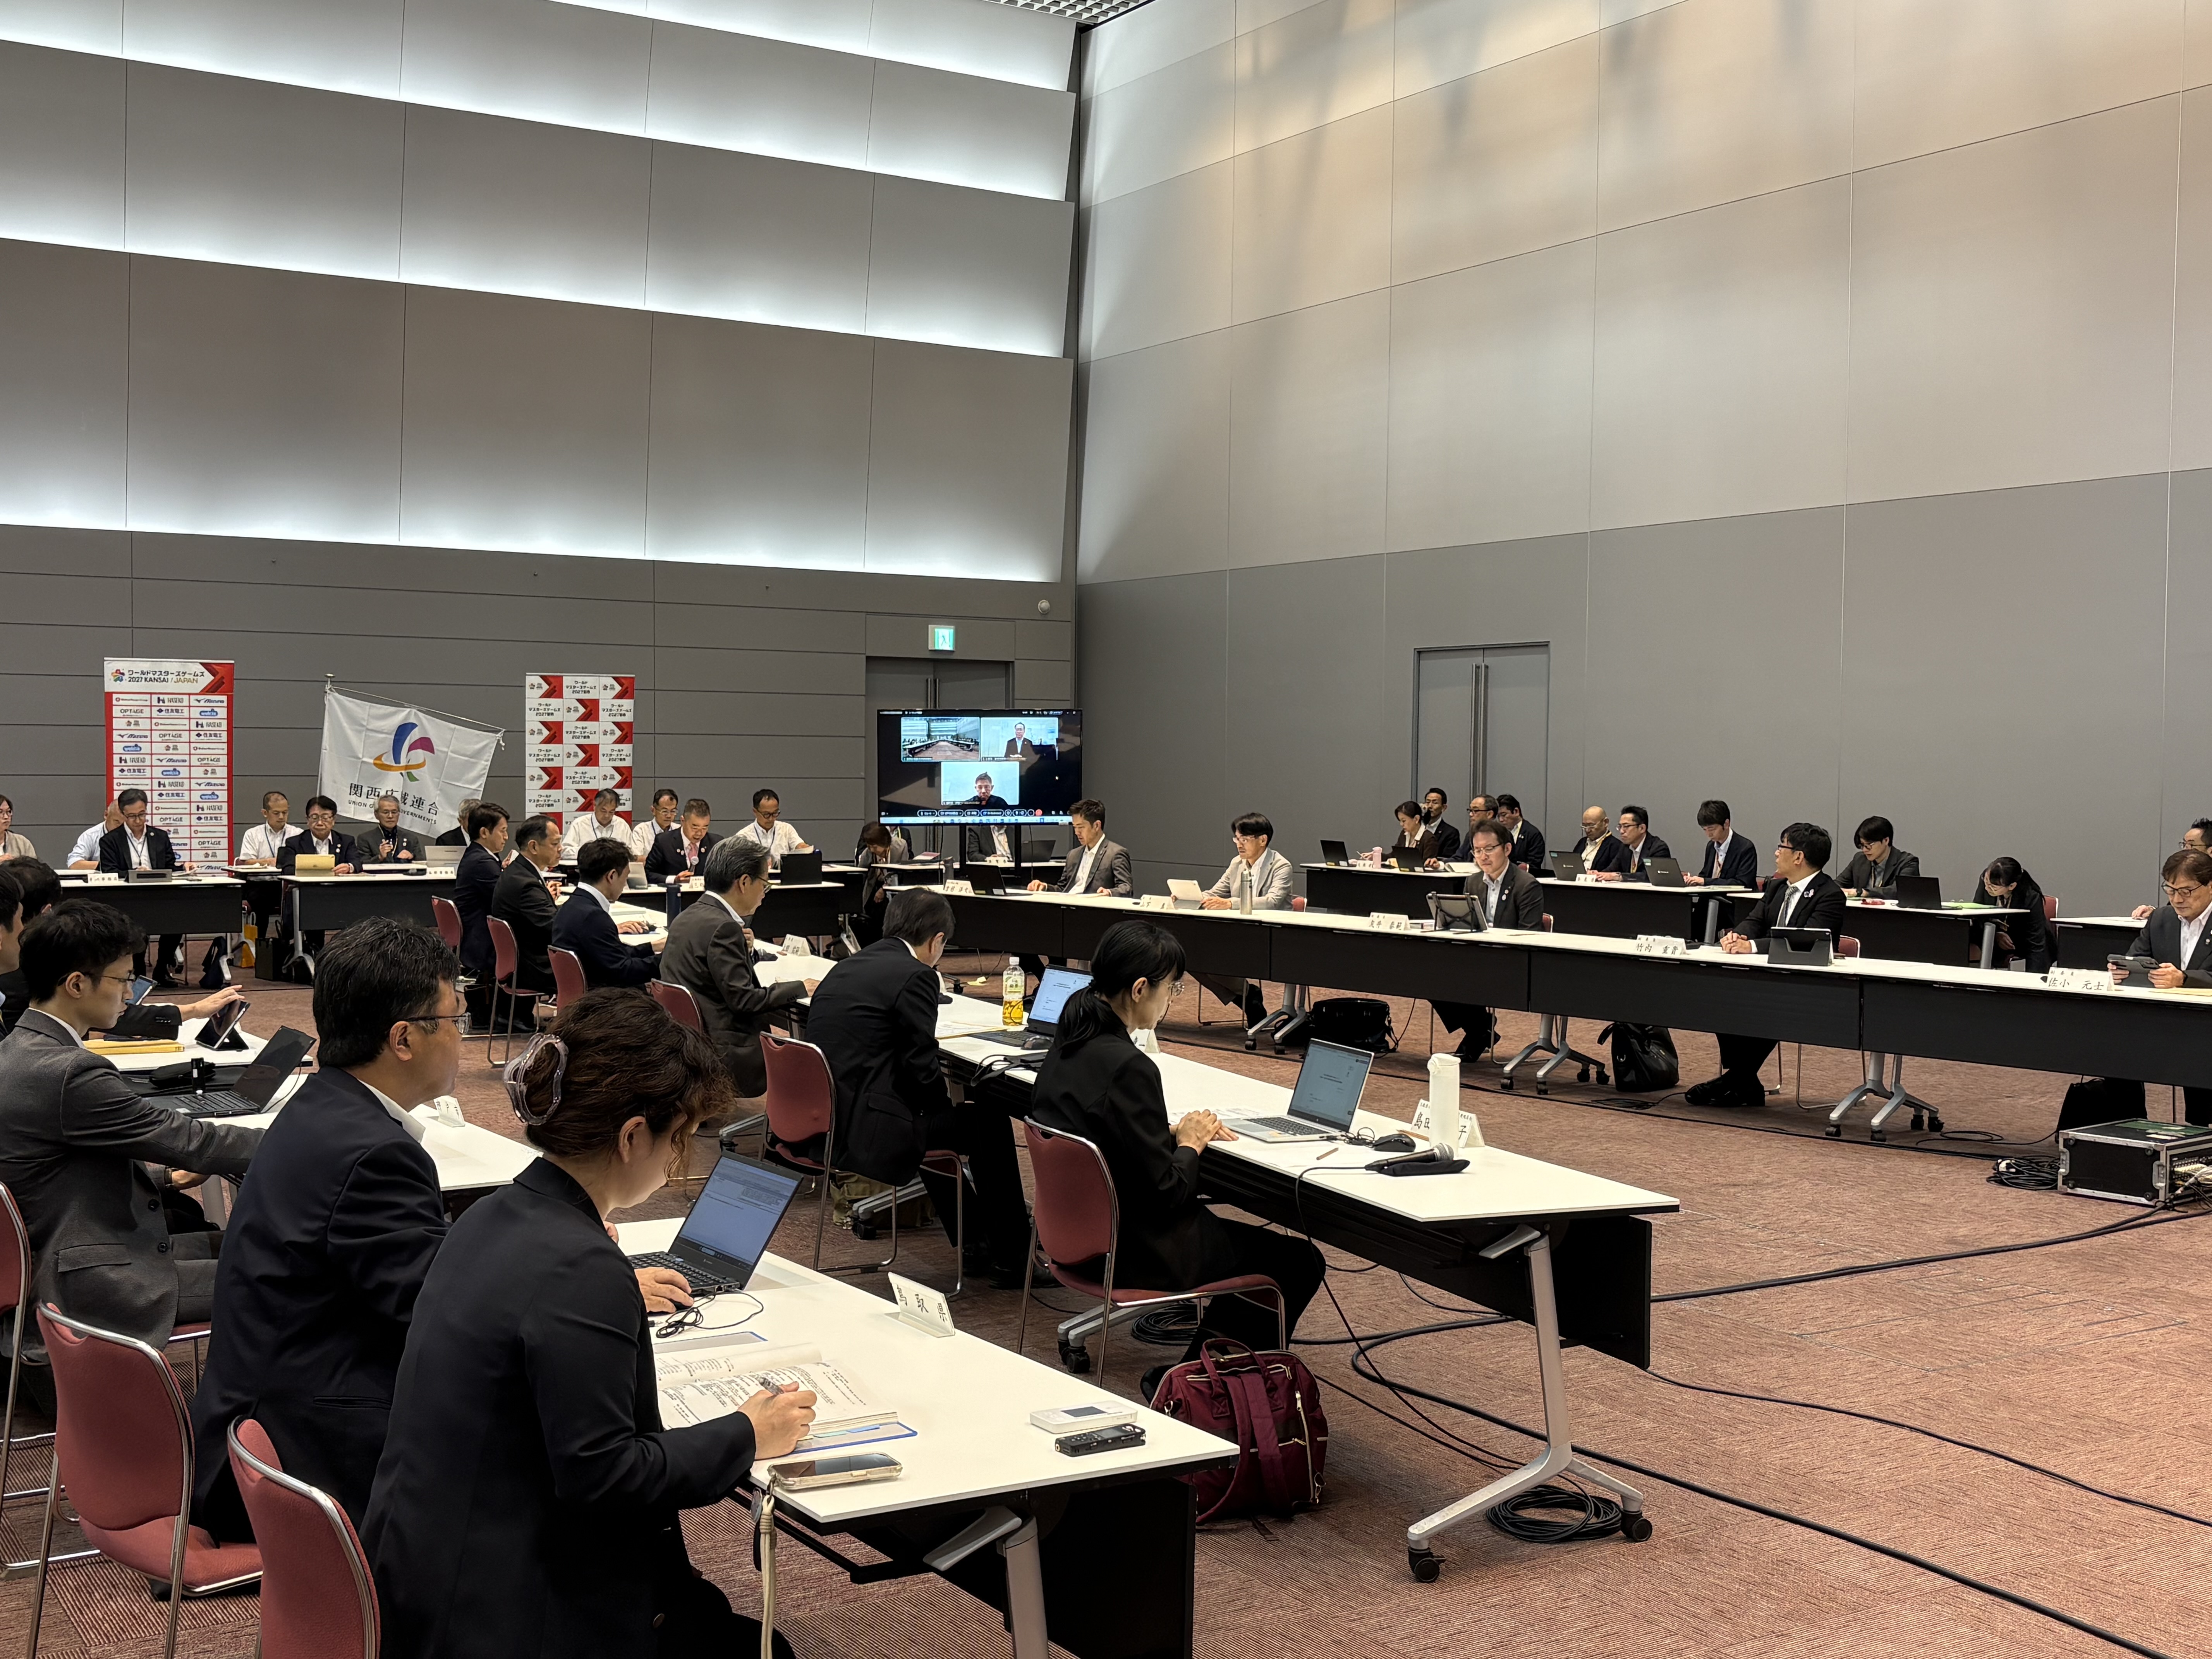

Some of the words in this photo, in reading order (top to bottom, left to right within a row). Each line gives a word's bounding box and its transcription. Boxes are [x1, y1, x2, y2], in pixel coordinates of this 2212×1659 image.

[400, 809, 436, 824] OVERNMENTS
[897, 1284, 948, 1322] 鳥取県
